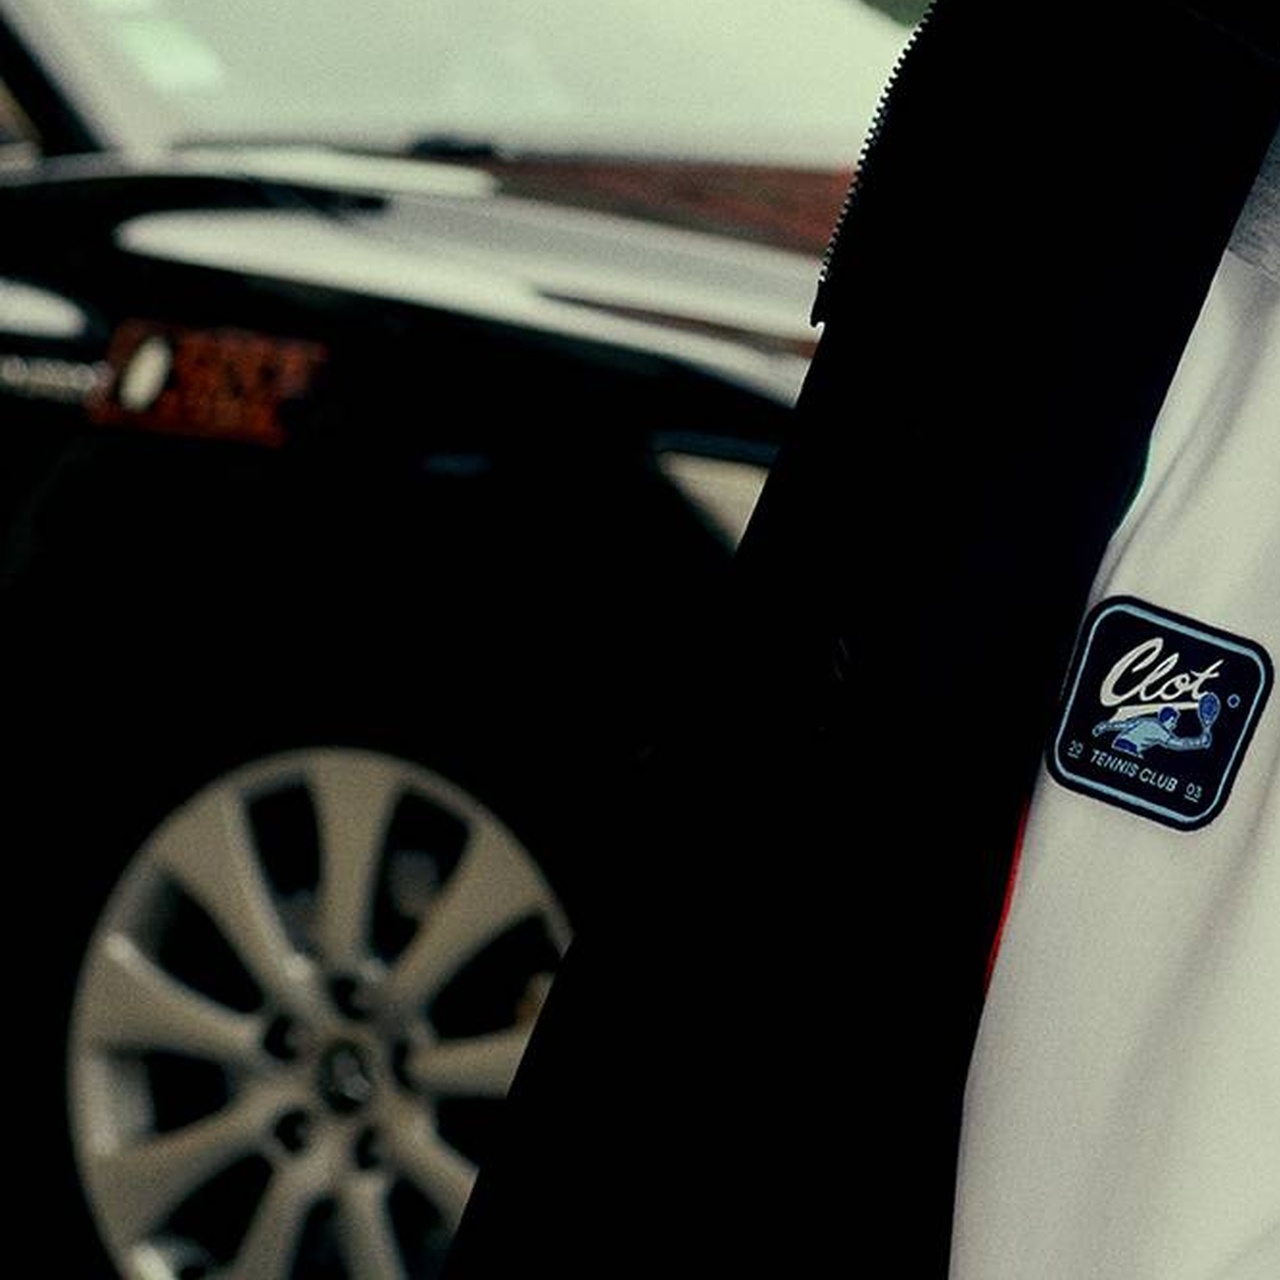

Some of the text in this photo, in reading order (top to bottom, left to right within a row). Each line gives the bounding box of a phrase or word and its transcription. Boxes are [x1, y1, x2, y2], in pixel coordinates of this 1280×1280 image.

[1100, 637, 1225, 707] Clot
[1090, 749, 1139, 778] TENNIS
[1140, 767, 1178, 792] CLUB
